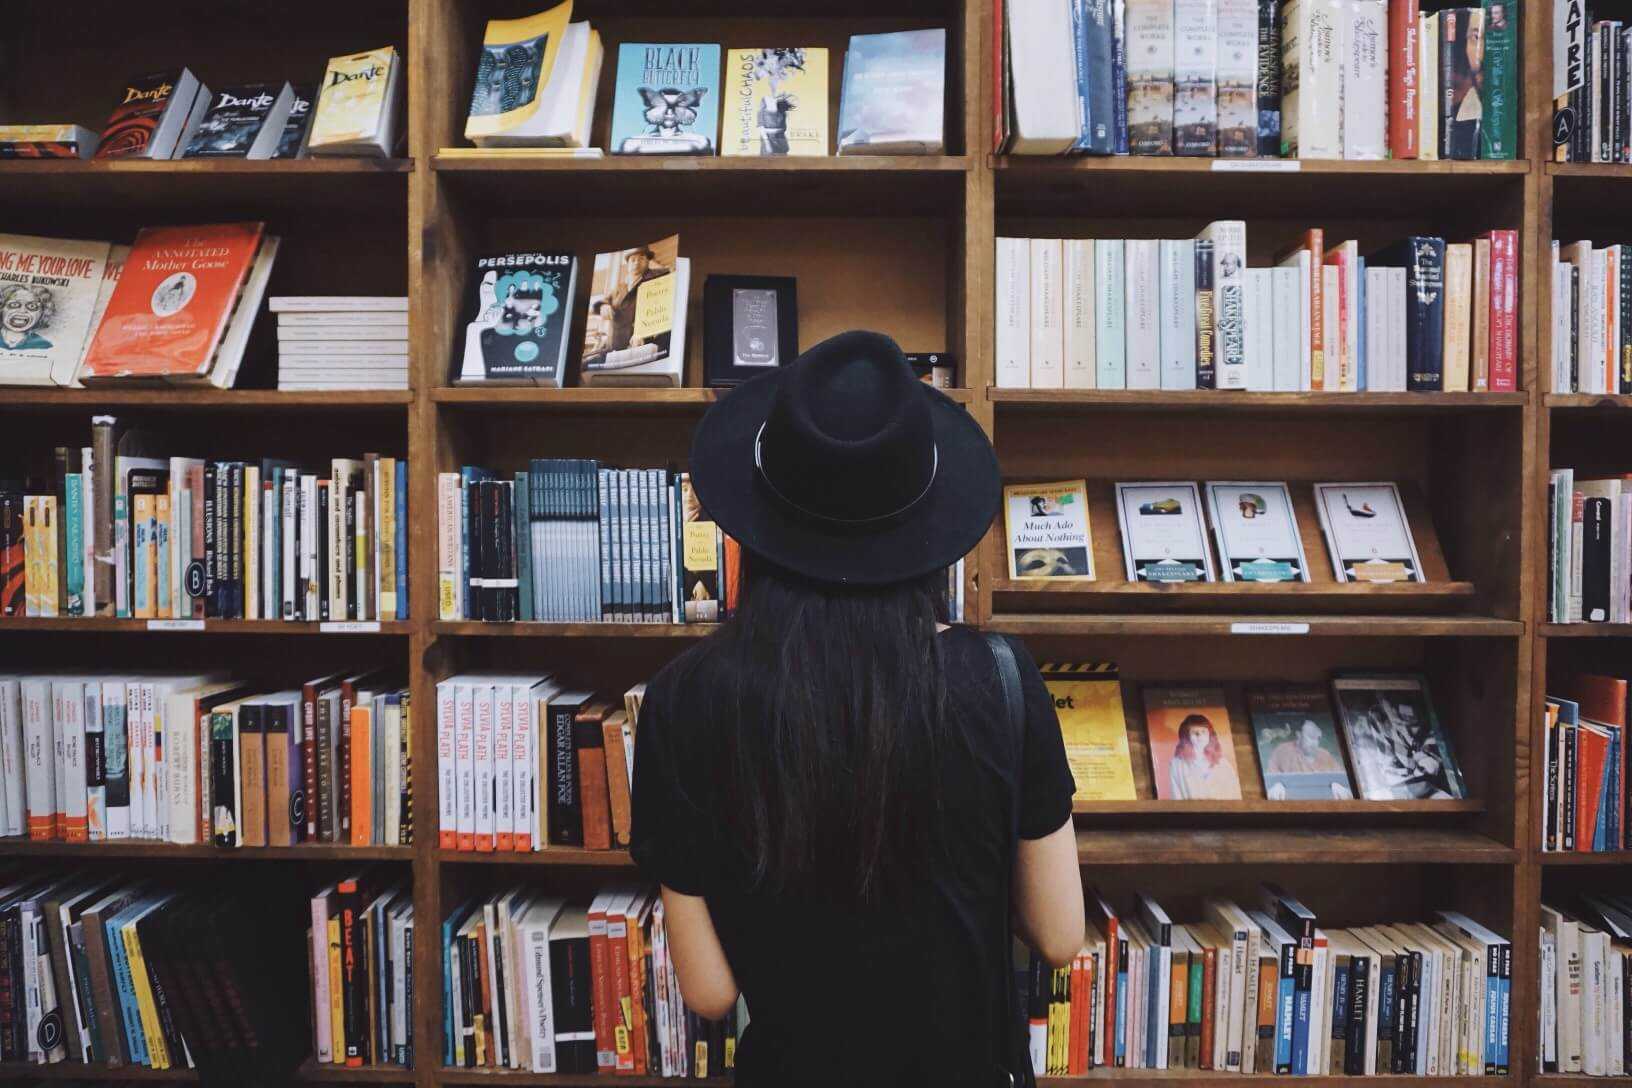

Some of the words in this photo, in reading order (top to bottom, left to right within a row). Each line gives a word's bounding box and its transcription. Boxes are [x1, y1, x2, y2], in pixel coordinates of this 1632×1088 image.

[1567, 0, 1582, 90] ATRE
[645, 47, 701, 71] BLACK
[1259, 44, 1269, 97] EVIDENCE
[328, 63, 386, 88] Dante
[740, 54, 755, 95] CHAOS
[124, 81, 173, 103] Dante
[218, 92, 274, 109] Dante
[1557, 117, 1569, 137] A
[17, 253, 36, 272] ME
[39, 255, 66, 277] YOUR
[67, 258, 95, 279] LOVE
[478, 254, 569, 268] PERSEPOLIS
[32, 276, 71, 288] BUKOWSKI
[1199, 290, 1213, 308] Five
[1199, 309, 1213, 329] Great
[1219, 285, 1241, 365] SHAKESPEARE
[1199, 330, 1213, 368] Comedies
[205, 500, 214, 544] ILLUSIONS
[1024, 519, 1051, 530] Much
[1053, 519, 1074, 529] Ado
[1015, 533, 1043, 544] About
[1045, 532, 1086, 545] Nothing
[191, 570, 200, 589] B
[443, 700, 453, 728] SYLVIA
[1050, 693, 1074, 709] let
[461, 702, 471, 730] SYLVIA
[480, 703, 490, 731] SYLVIA
[500, 702, 510, 730] SYLVIA
[518, 702, 528, 731] SYLVIA
[440, 731, 450, 757] PLATH
[556, 714, 565, 748] EDGAR
[457, 733, 467, 759] PLATH
[476, 734, 486, 760] PLATH
[497, 733, 507, 760] PLATH
[514, 733, 525, 760] PLATH
[556, 749, 565, 782] ALLAN
[1549, 759, 1558, 773] The
[556, 784, 565, 804] POE
[343, 908, 354, 984] BEAT
[535, 946, 544, 978] Edmund
[1235, 945, 1244, 975] Hamlet
[1247, 959, 1257, 1002] HAMLET
[536, 978, 546, 1014] Spenser's
[1299, 993, 1307, 1022] HAMLET
[1352, 978, 1365, 1022] HAMLET
[538, 1014, 548, 1039] Poetry
[1284, 995, 1293, 1041] HAMLET
[1489, 1015, 1497, 1045] CAESAR
[45, 1021, 56, 1043] D
